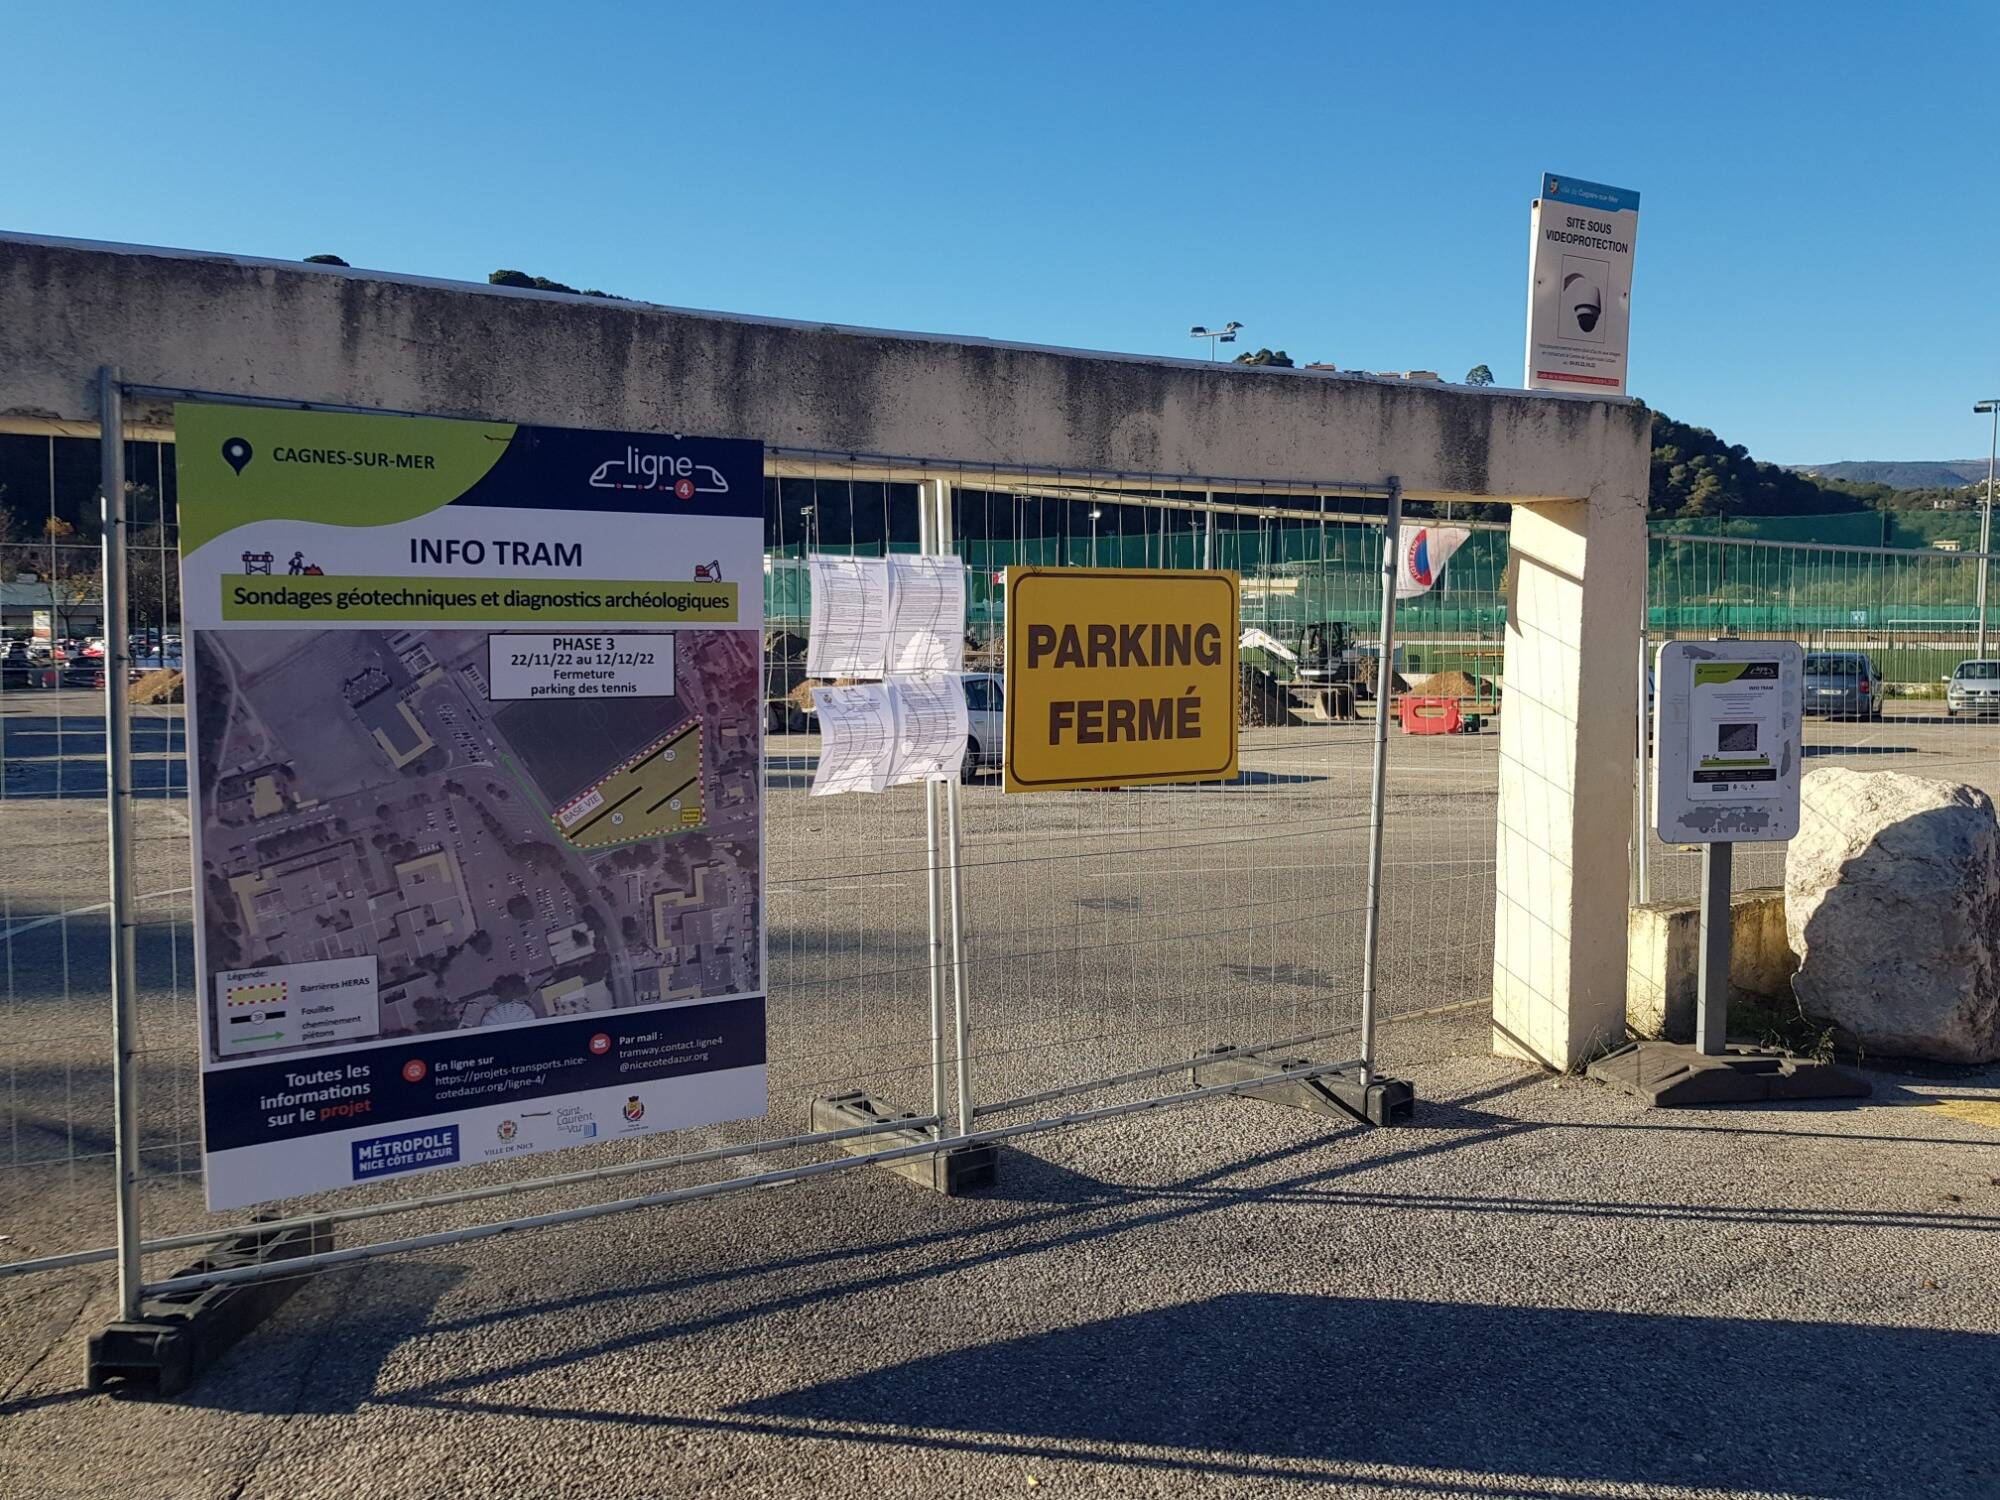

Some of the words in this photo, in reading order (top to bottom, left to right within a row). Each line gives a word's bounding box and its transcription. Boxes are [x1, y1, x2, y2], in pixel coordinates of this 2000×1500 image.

[1566, 216, 1586, 230] SITE
[1587, 221, 1612, 235] SOUS
[1546, 229, 1628, 253] VIDEOPROTECTION
[273, 447, 435, 469] CAGNES-SUR-MER
[627, 445, 693, 489] ligne
[680, 483, 689, 495] 4
[410, 538, 486, 565] INFO
[492, 541, 582, 567] TRAM
[234, 587, 333, 609] Sondages
[336, 588, 477, 610] géotechniques
[481, 590, 500, 607] et
[503, 590, 602, 611] diagnostics
[605, 591, 730, 612] archéologiques
[552, 638, 602, 651] PHASE
[606, 638, 615, 651] 3
[1027, 623, 1222, 669] PARKING
[511, 653, 572, 667] 22/11/22
[576, 656, 592, 665] au
[596, 653, 655, 667] 12/12/22
[553, 669, 615, 680] Fermeture
[531, 684, 576, 697] parking
[579, 683, 599, 694] des
[601, 682, 637, 693] tennis
[1049, 685, 1202, 745] FERMÉ
[563, 803, 585, 823] BASE
[584, 794, 600, 807] VIE
[300, 982, 340, 993] Barrières
[341, 978, 371, 988] HERAS
[301, 1005, 335, 1016] Fouilles
[302, 1015, 362, 1029] cheminement
[302, 1029, 335, 1041] piétons
[620, 1036, 635, 1046] Par
[637, 1032, 658, 1044] mail
[434, 1062, 448, 1072] En
[450, 1059, 476, 1071] ligne
[477, 1056, 495, 1066] sur
[434, 1056, 588, 1086] https://projets-transports.nice-
[619, 1053, 709, 1073] @nicecotedazur.org
[285, 1067, 343, 1088] Toutes
[346, 1064, 371, 1078] les
[435, 1073, 547, 1100] cotedazur.org/ligne-4/
[260, 1082, 371, 1110] informations
[267, 1111, 297, 1128] sur
[300, 1107, 317, 1122] le
[319, 1099, 373, 1122] projet
[358, 1131, 453, 1161] MÉTROPOLE
[484, 1148, 504, 1156] VILLE
[516, 1142, 534, 1150] NICE
[359, 1159, 386, 1173] NICE
[386, 1153, 415, 1168] CÔTE
[415, 1147, 453, 1162] D'AZUR
